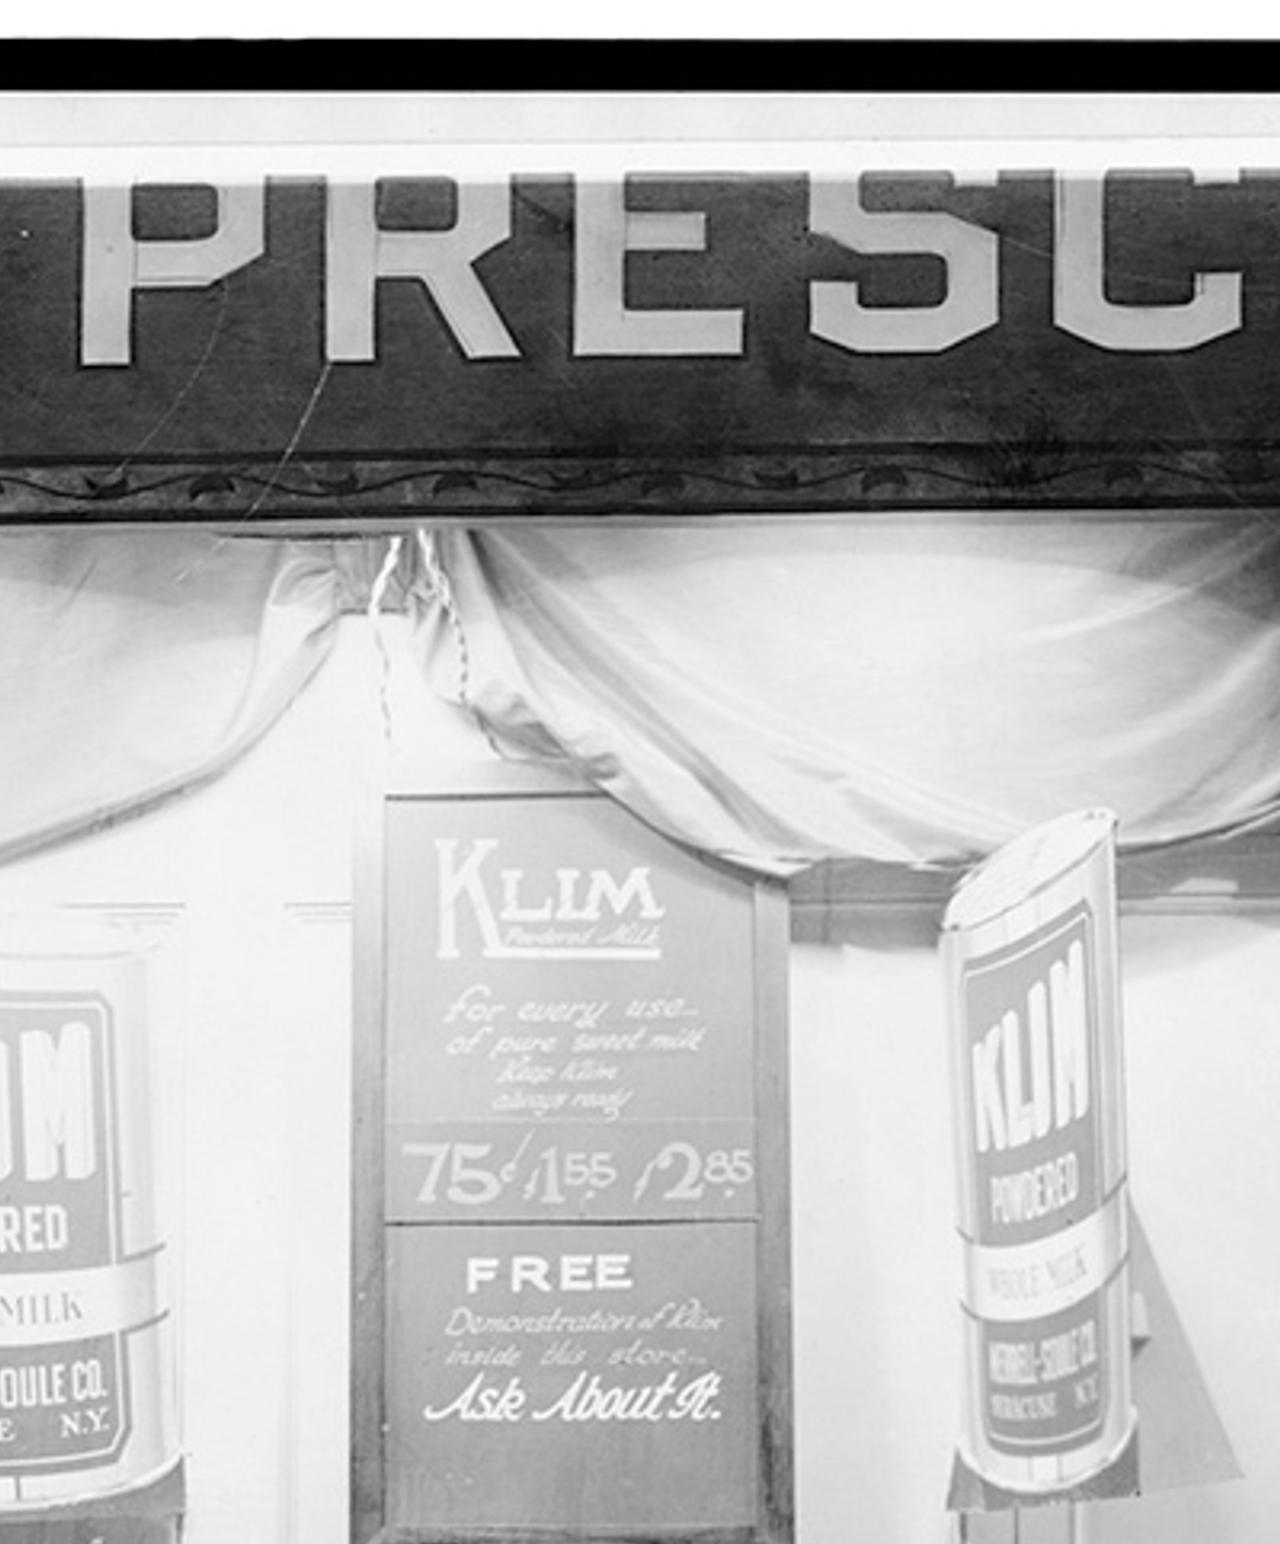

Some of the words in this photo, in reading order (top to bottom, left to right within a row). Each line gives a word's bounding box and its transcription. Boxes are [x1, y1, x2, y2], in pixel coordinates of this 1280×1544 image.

[433, 836, 667, 961] KLIM
[442, 982, 506, 1025] for
[519, 1000, 608, 1030] every
[444, 1025, 494, 1057] of
[489, 1036, 558, 1060] pure
[571, 1025, 643, 1054] sweet
[972, 937, 1088, 1154] KLIM
[990, 1150, 1080, 1225] POWDERED
[466, 1252, 634, 1294] FREE
[443, 1304, 639, 1337] Demonstration
[539, 1337, 588, 1366] this
[72, 1358, 109, 1401] CO.
[423, 1369, 527, 1421] Ask
[531, 1369, 679, 1422] About
[666, 1369, 723, 1422] It.
[59, 1403, 112, 1440] N.Y.
